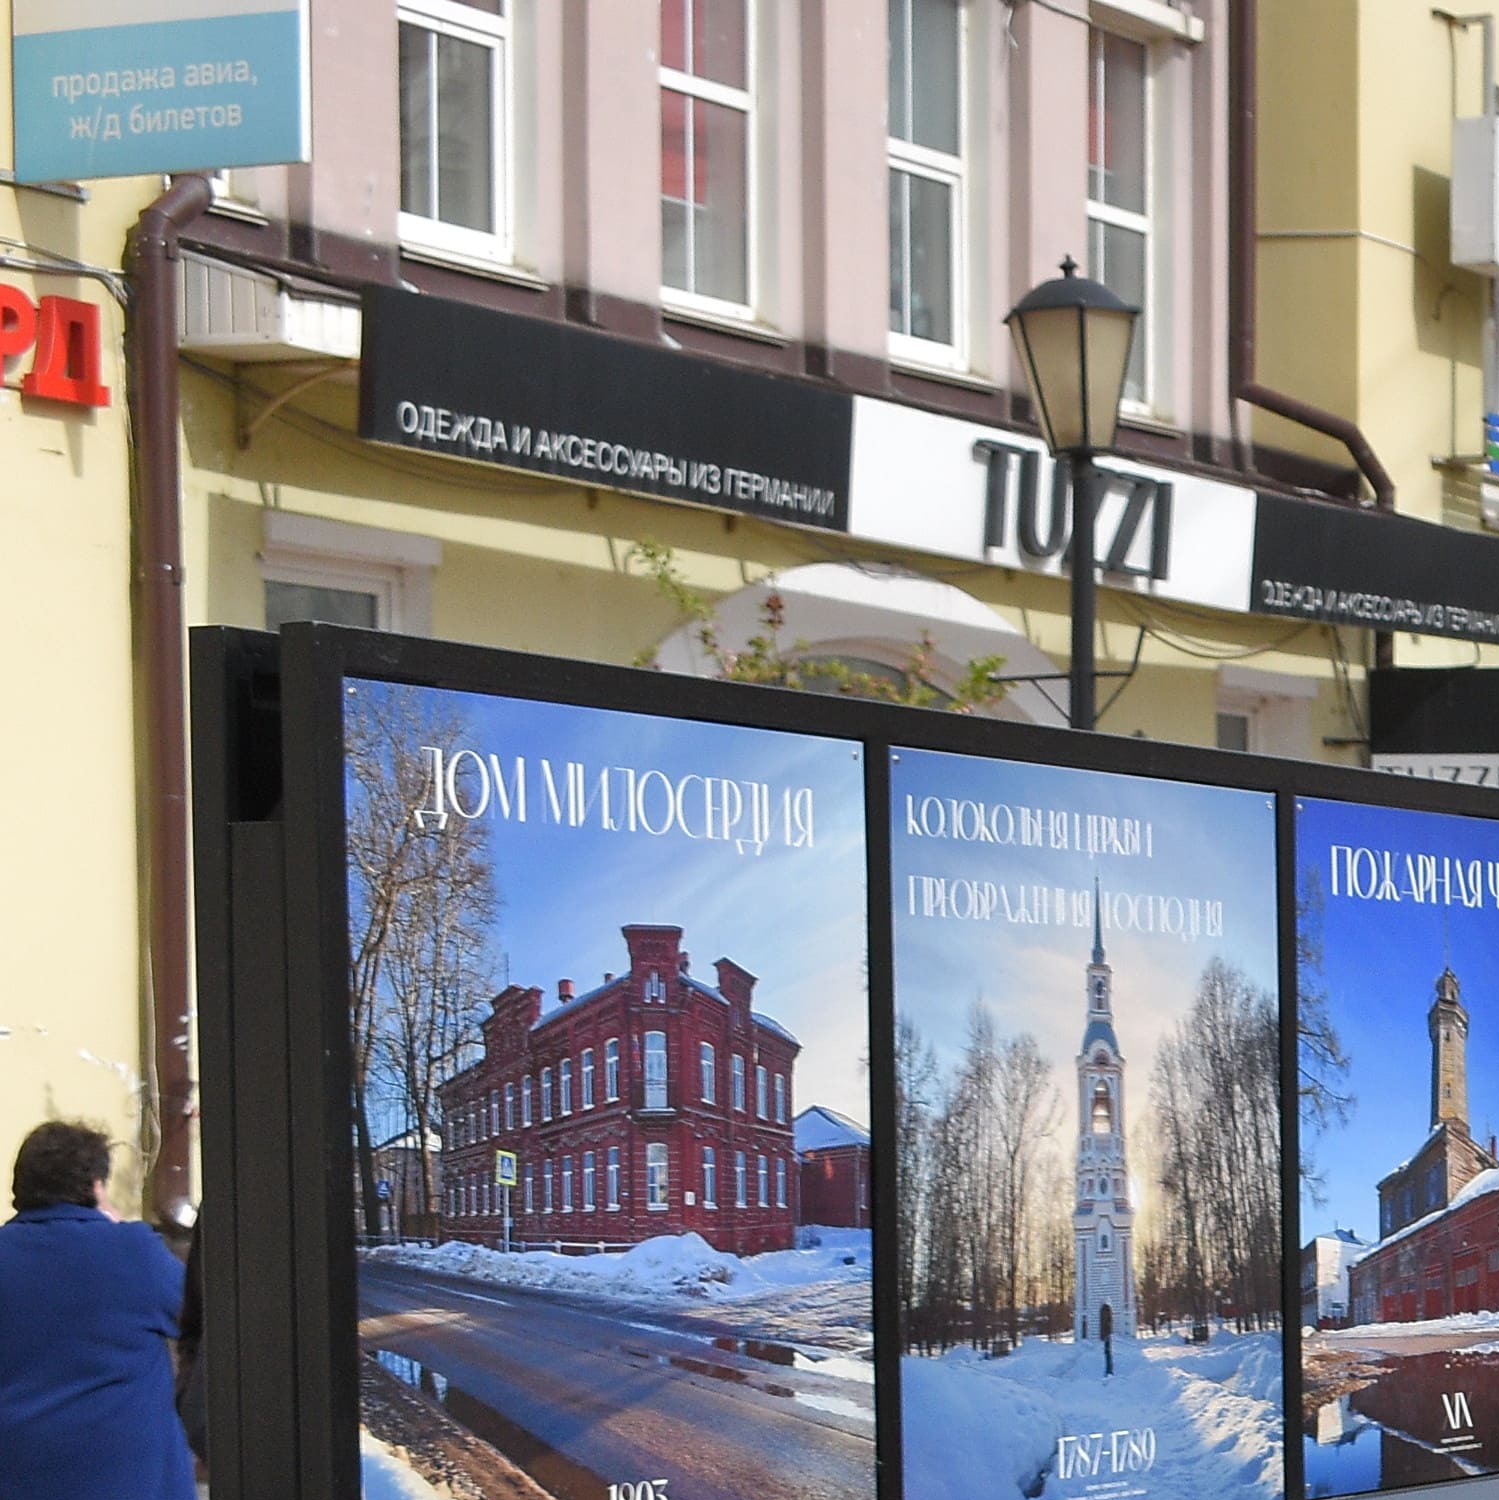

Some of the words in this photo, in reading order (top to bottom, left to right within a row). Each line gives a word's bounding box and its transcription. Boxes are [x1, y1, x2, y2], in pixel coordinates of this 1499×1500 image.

[53, 65, 176, 103] продажа
[184, 59, 258, 87] авиа,
[70, 106, 122, 141] ж/д
[129, 103, 243, 134] билетов
[399, 401, 509, 451] ОДЕЖДА
[512, 426, 532, 454] И
[534, 429, 687, 486] АКСЕССУАРЫ
[690, 462, 721, 494] ИЗ
[724, 467, 835, 516] ГЕРМАНИИ
[413, 746, 526, 830] ДОМ
[541, 758, 815, 857] МИЛОСЕРДИЯ
[1331, 845, 1482, 908] ПОЖАРНАЯ
[1058, 1427, 1156, 1480] 1787-1789
